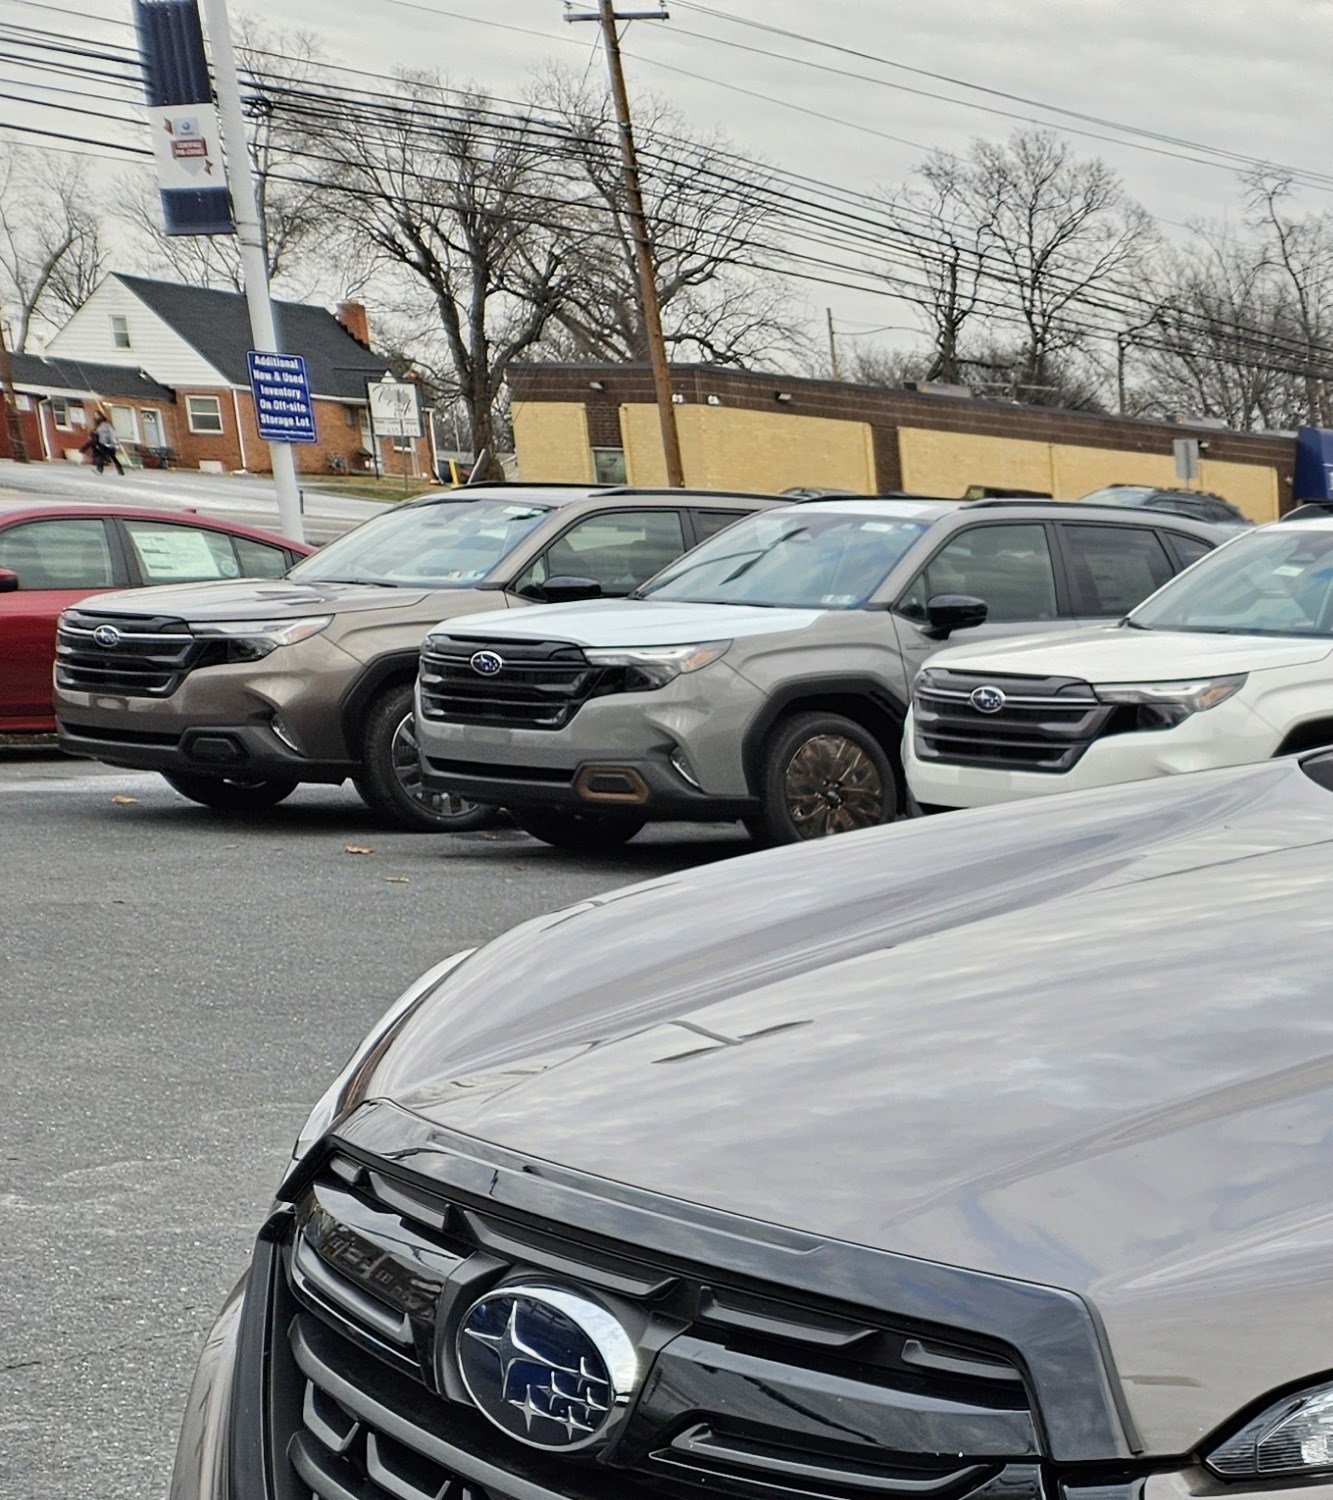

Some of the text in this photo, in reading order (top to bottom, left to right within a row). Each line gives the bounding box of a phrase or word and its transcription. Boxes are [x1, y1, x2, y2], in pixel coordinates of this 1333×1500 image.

[254, 355, 299, 369] Additional
[253, 369, 304, 384] New & Used
[260, 384, 301, 400] Inventory
[260, 398, 307, 413] On Off-site
[260, 413, 310, 427] Storage Lot
